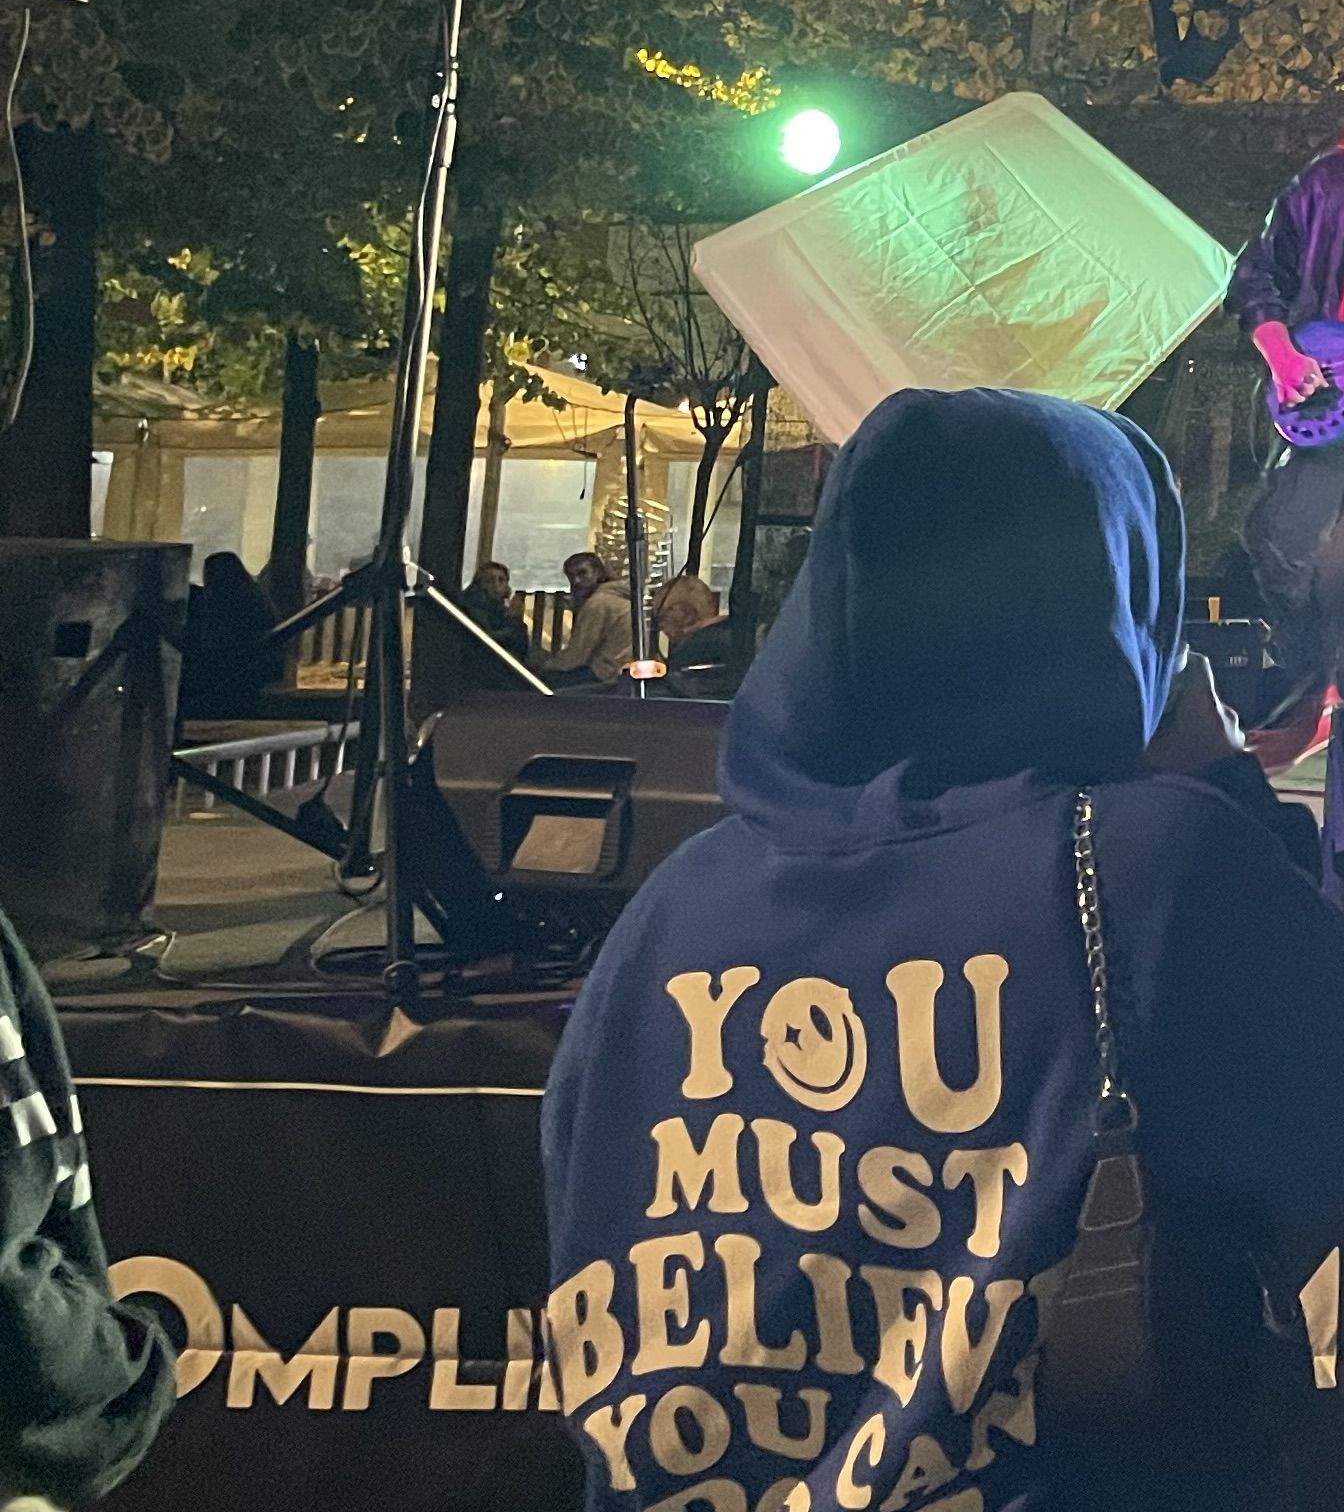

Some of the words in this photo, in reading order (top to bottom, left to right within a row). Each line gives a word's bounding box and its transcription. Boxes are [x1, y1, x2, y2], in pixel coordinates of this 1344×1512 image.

[666, 953, 1010, 1134] YOU
[645, 1112, 1029, 1259] MUST
[107, 1254, 566, 1411] OMPLI
[548, 1230, 1026, 1416] BELIEV
[583, 1382, 832, 1491] YOU
